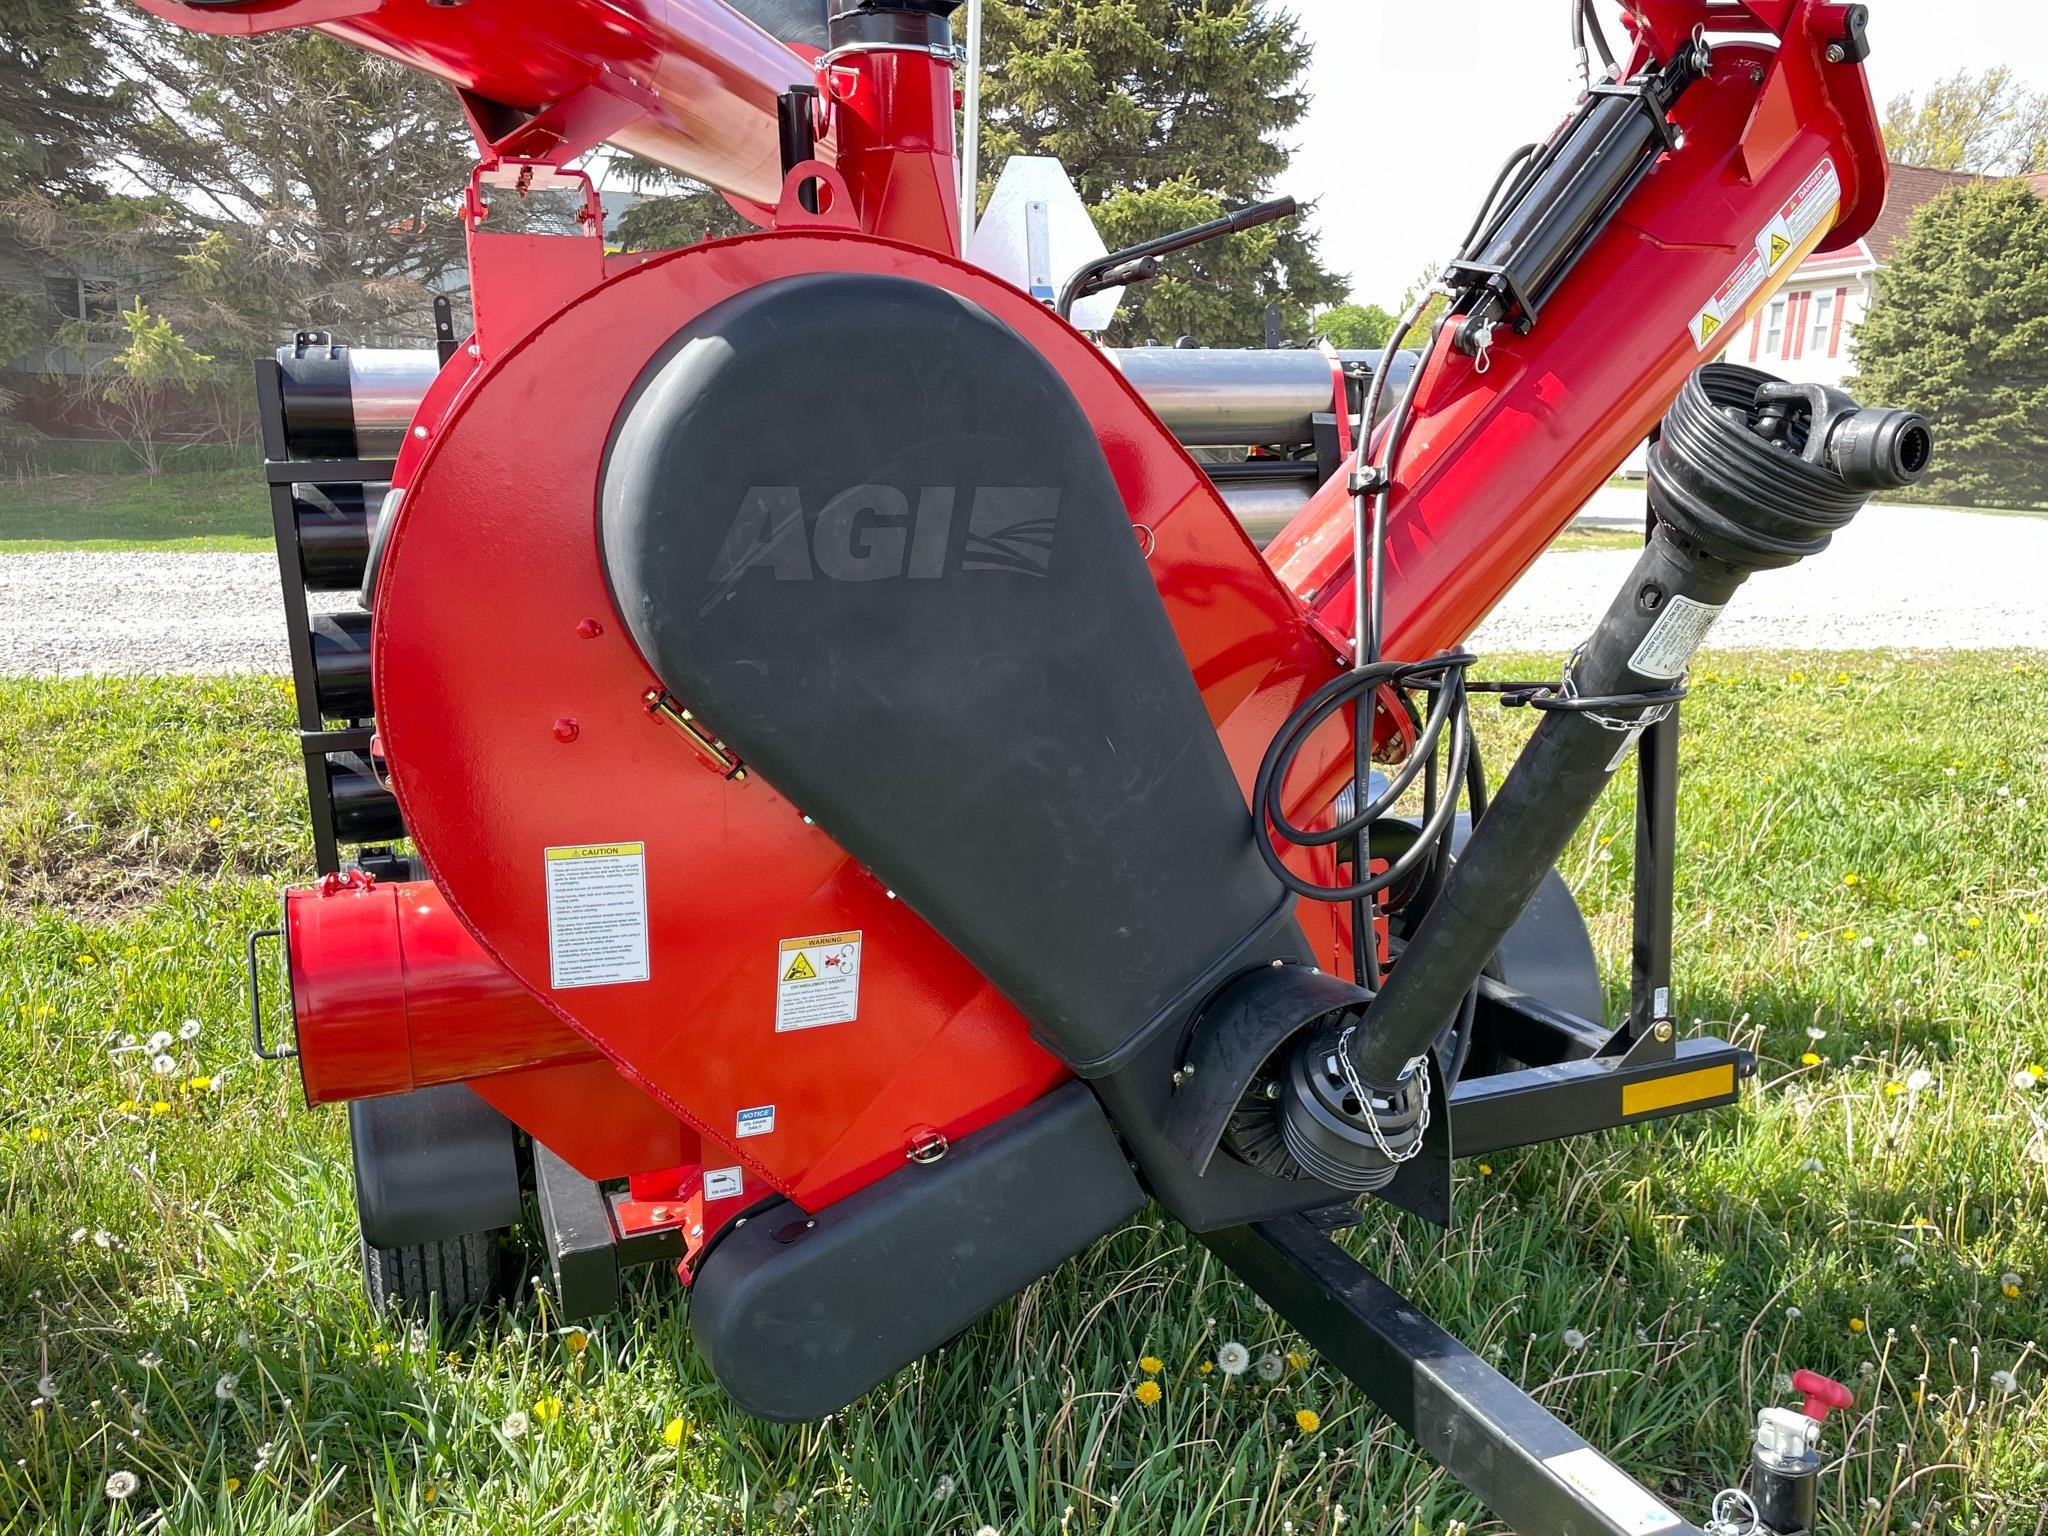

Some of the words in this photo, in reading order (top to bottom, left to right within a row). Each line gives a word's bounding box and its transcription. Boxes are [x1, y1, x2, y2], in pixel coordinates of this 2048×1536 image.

[1797, 168, 1825, 199] DANGER
[706, 484, 956, 582] AGI
[1668, 611, 1676, 621] NOT
[1660, 621, 1668, 631] USE
[1653, 631, 1661, 641] PTO
[581, 847, 619, 857] CAUTION
[808, 937, 842, 946] WARNING
[742, 1110, 770, 1119] NOTICE
